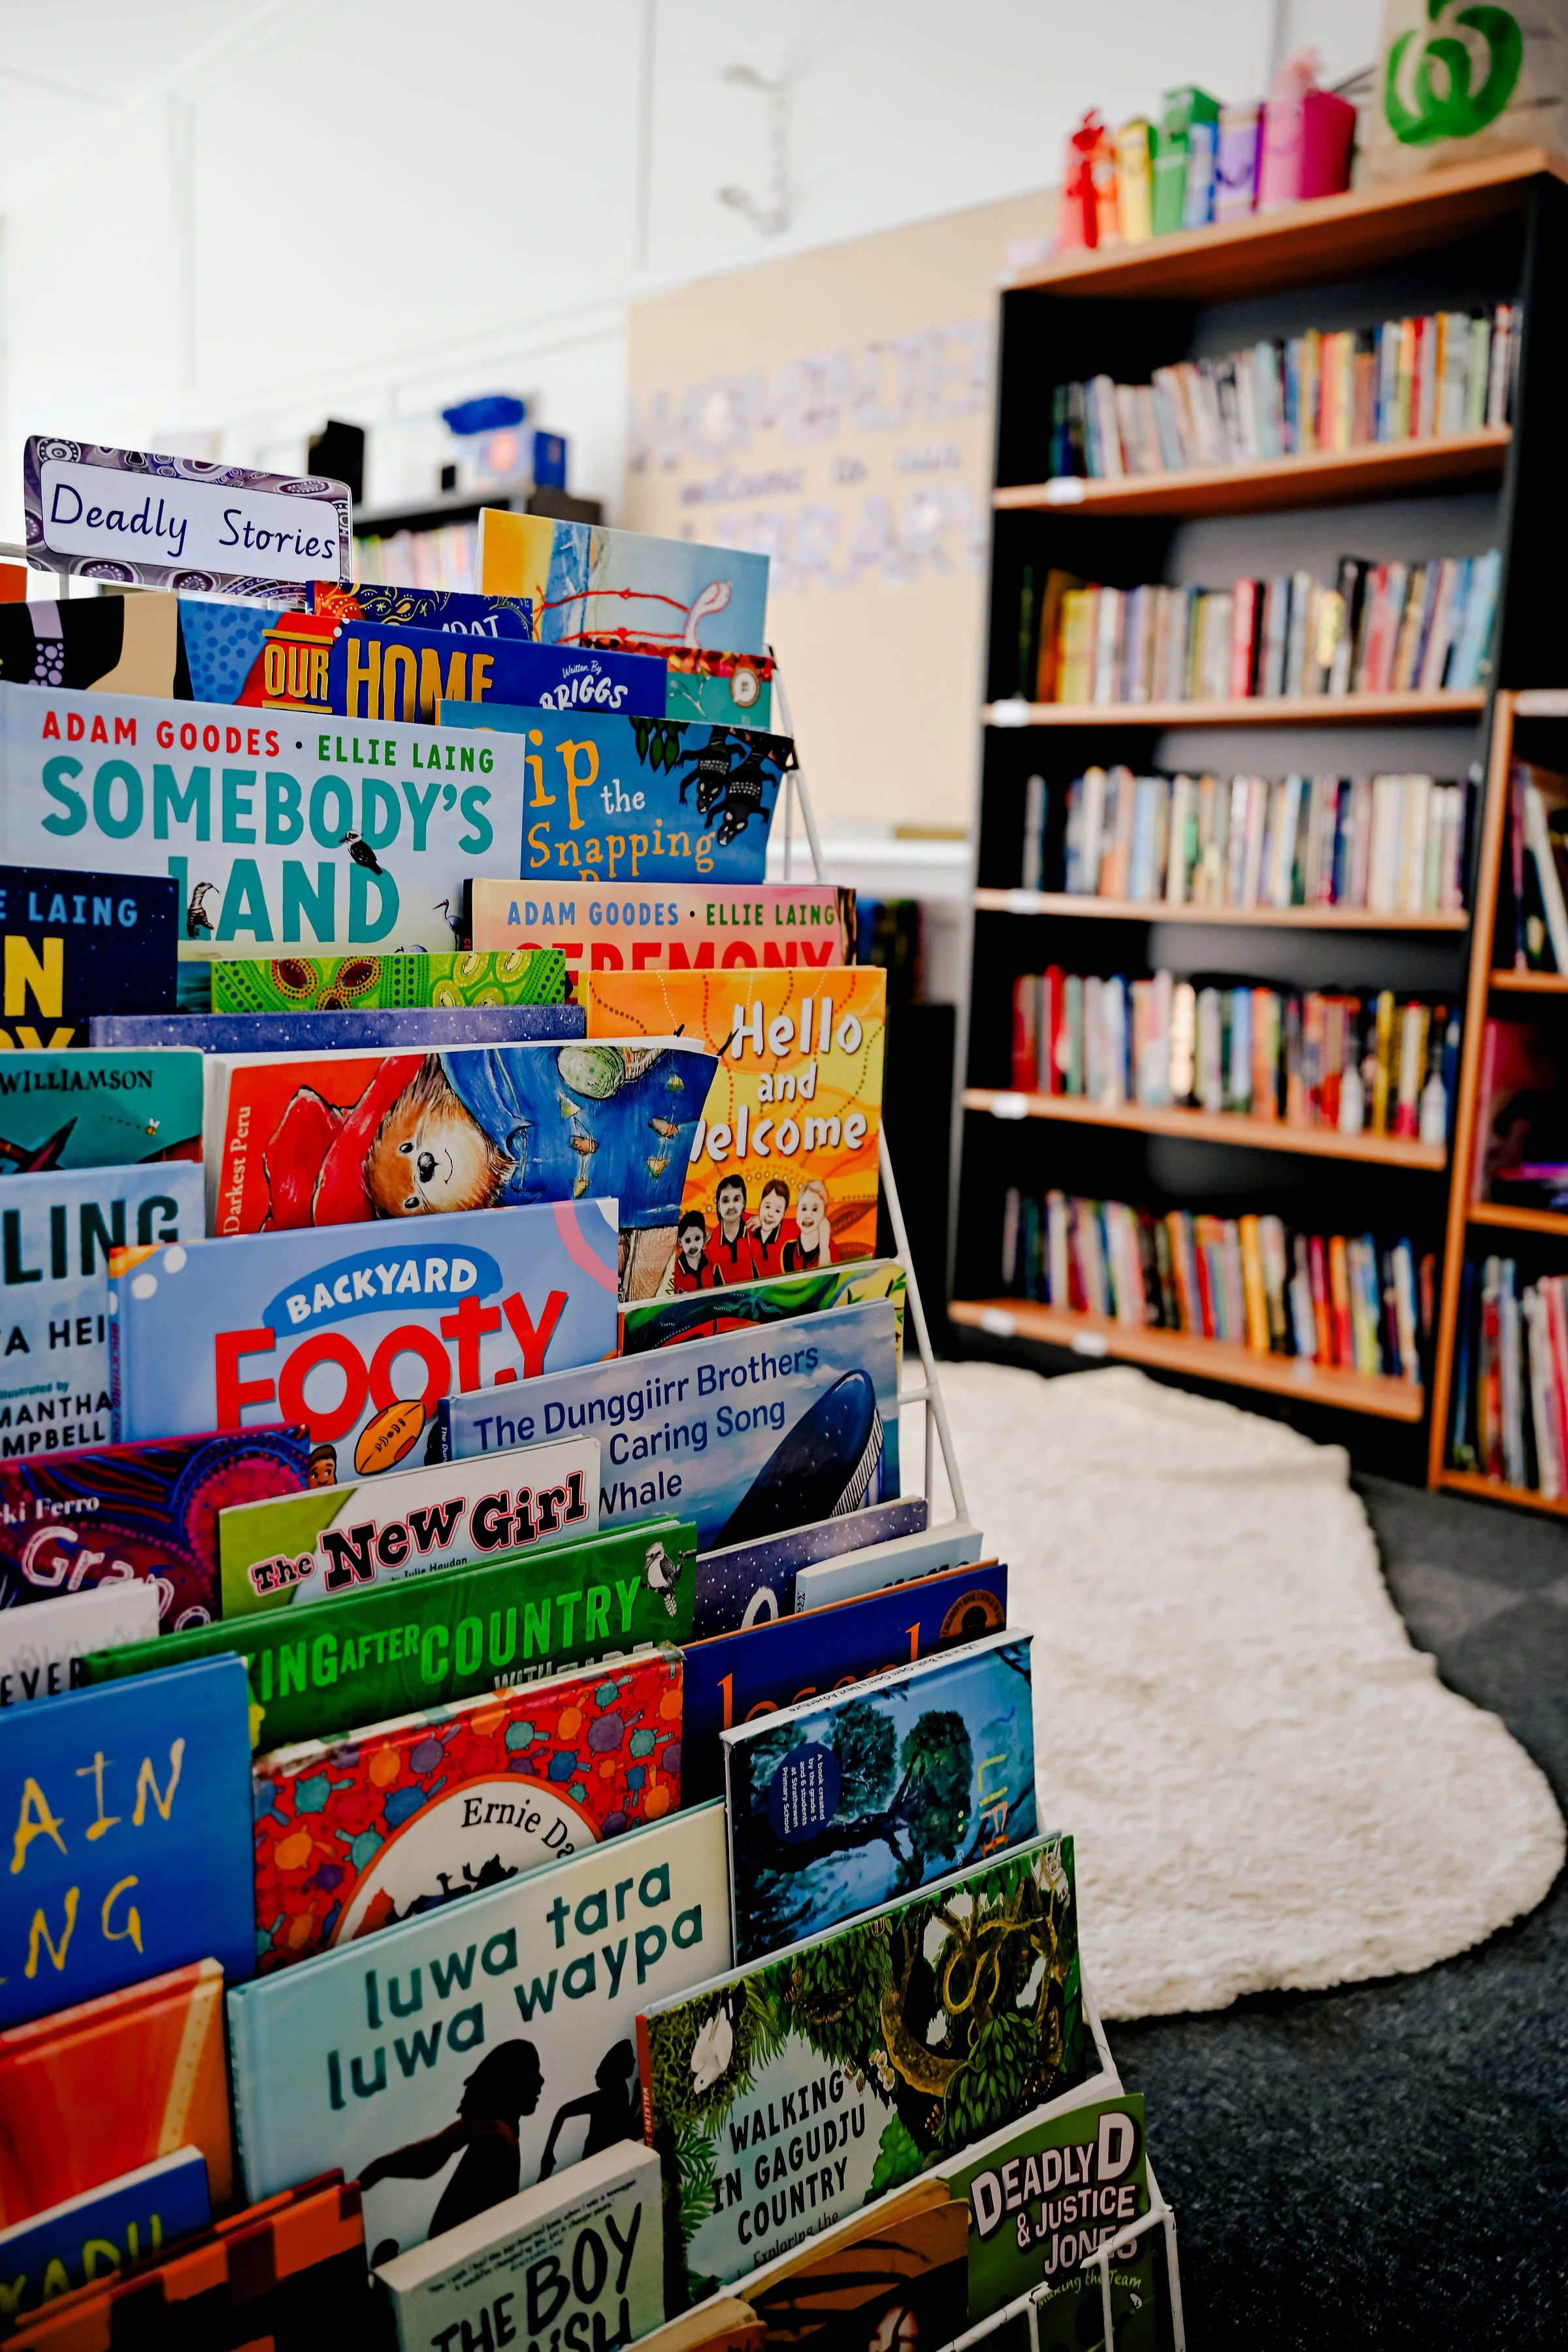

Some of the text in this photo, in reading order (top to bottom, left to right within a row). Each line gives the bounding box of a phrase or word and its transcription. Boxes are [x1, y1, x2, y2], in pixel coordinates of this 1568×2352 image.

[50, 483, 336, 559] Deadly Stories
[265, 638, 494, 724] OUR HOME
[539, 674, 628, 711] BRIGGS
[563, 660, 602, 678] Written By
[42, 711, 494, 774] ADAM GOODES ELLIE LAING
[42, 756, 494, 855] SOMEBODY'S
[600, 779, 645, 814] the
[528, 819, 715, 874] Snapping
[29, 892, 138, 928] LAING
[168, 857, 399, 943] LAND
[507, 901, 835, 926] ADAM GOODES ELLIE LAING
[732, 997, 862, 1060] Hello
[0, 1068, 154, 1095] WILLIAMSON
[758, 1064, 817, 1102] and
[223, 1105, 251, 1234] Darkest Peru
[286, 1258, 478, 1324] BACKYARD
[474, 1347, 819, 1450] The Dunggiirr Brothers
[610, 1401, 785, 1465] Caring Song
[36, 1497, 99, 1520] Ferro
[249, 1471, 585, 1594] The New Girl
[340, 1624, 420, 1674] AFTER
[421, 1576, 641, 1686] COUNTRY
[791, 1767, 796, 1776] at
[808, 1757, 815, 1769] by
[461, 1797, 541, 1833] Ernie
[365, 1862, 672, 2029] luwa tara
[327, 2002, 485, 2110] luwa
[514, 1904, 703, 2022] waypa
[730, 2070, 843, 2155] WALKING
[712, 2103, 865, 2214] IN GAGUDJU
[971, 2112, 1134, 2236] DEADLY D
[738, 2156, 847, 2245] COUNTRY
[817, 2212, 838, 2234] the
[1017, 2185, 1135, 2247] & JUSTICE
[431, 2202, 642, 2352] THE BOY
